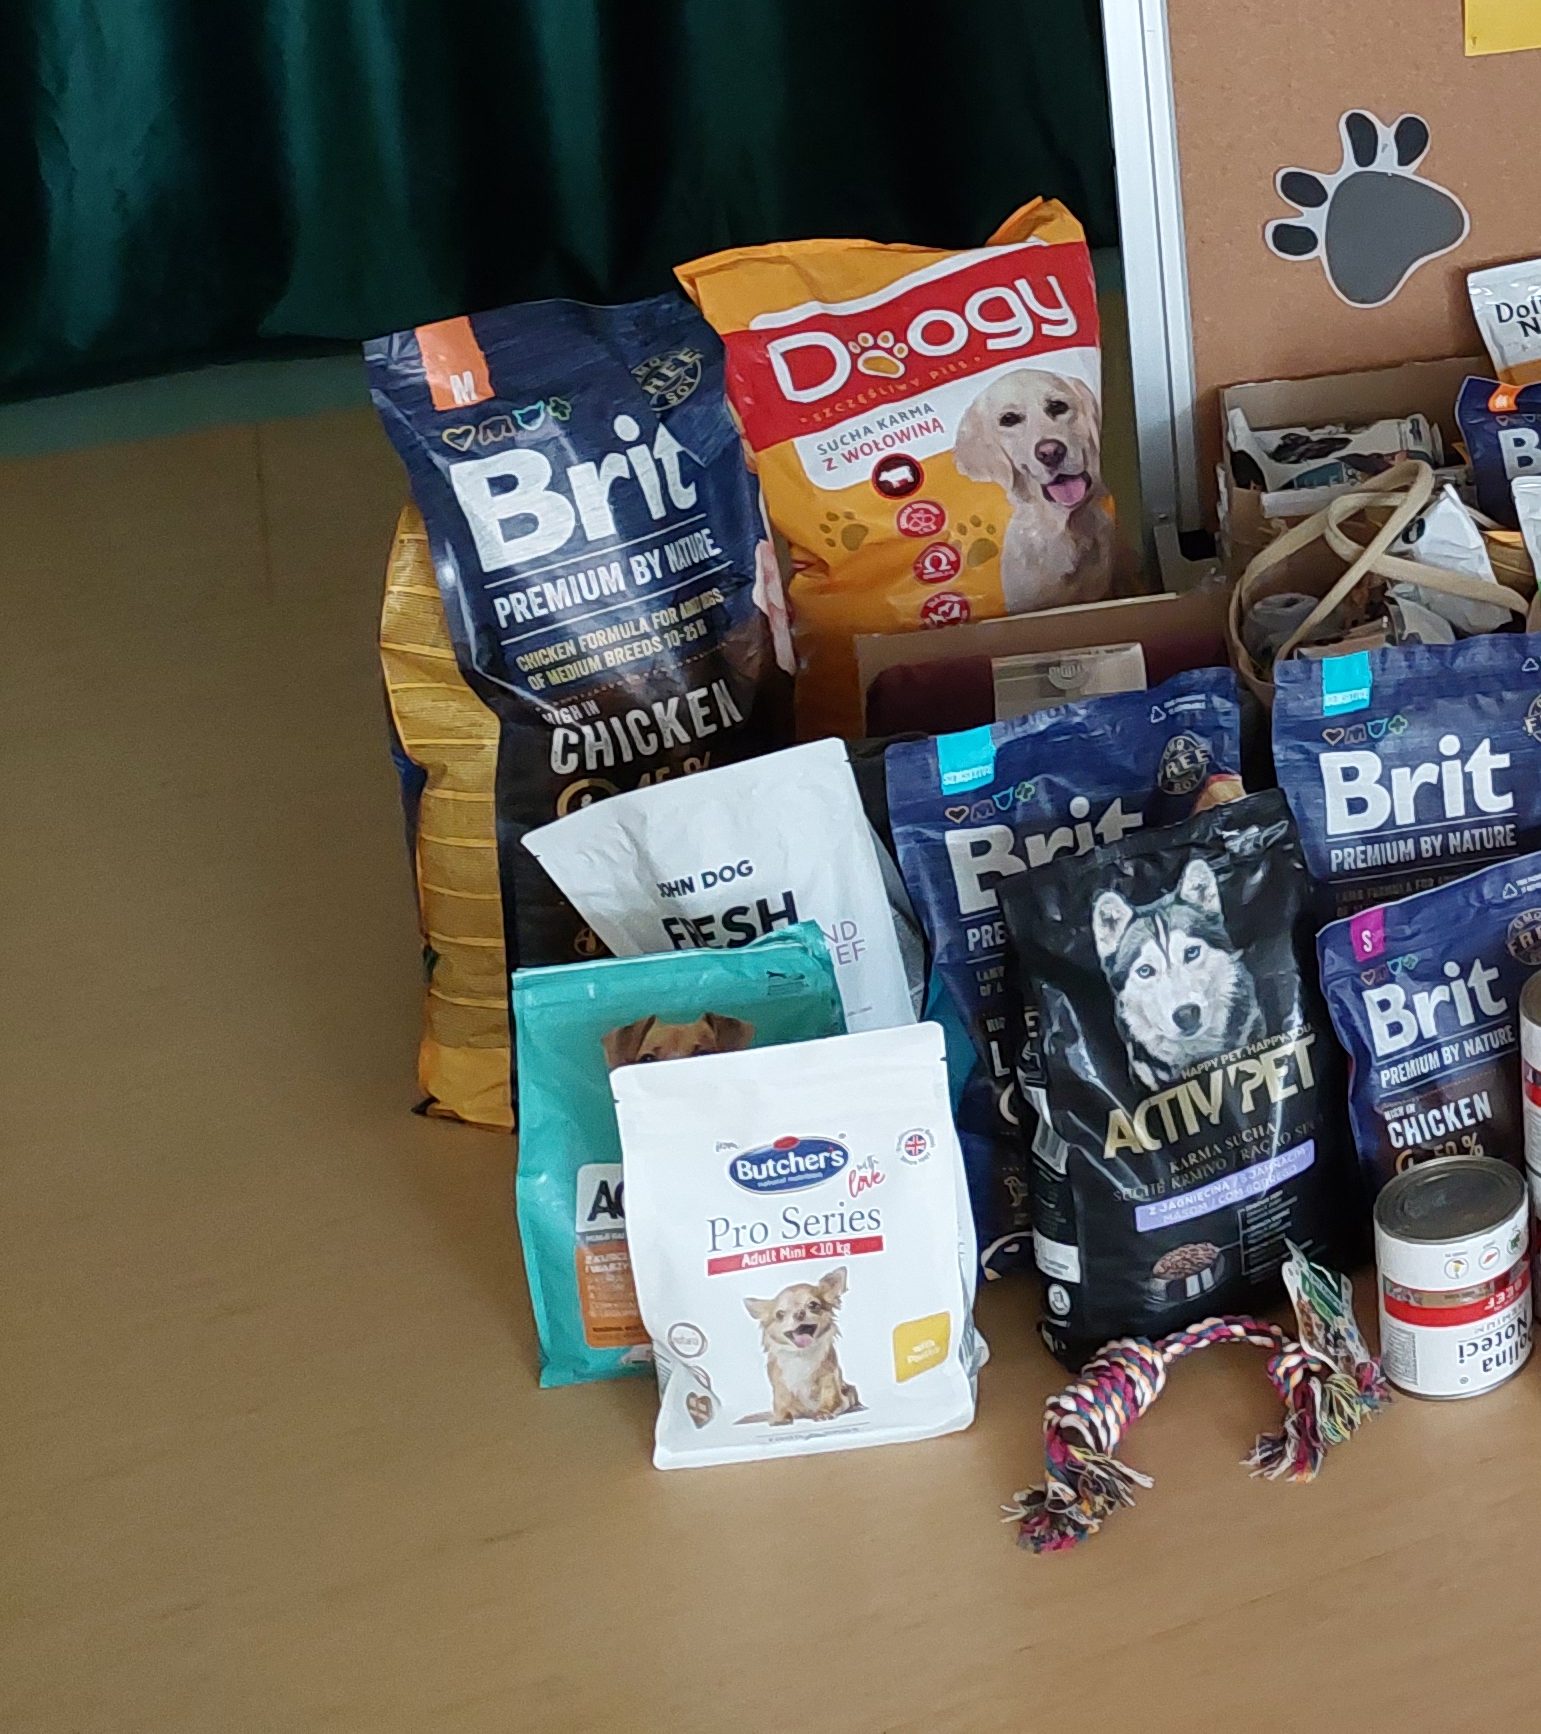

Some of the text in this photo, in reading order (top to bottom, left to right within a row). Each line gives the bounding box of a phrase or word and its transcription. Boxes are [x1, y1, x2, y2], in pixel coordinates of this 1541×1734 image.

[450, 371, 478, 405] M
[816, 402, 935, 456] SUCHA KARMA
[822, 417, 945, 472] Z WOŁOWINĄ
[448, 415, 698, 573] Brit
[493, 552, 664, 629] PREMIUM BY
[579, 606, 678, 653] FORMULA FOR
[549, 655, 602, 685] MEDIUM
[550, 679, 744, 775] CHICKEN
[1318, 735, 1514, 835] Brit
[701, 859, 754, 890] DOG
[1330, 823, 1517, 873] PREMIUM BY NATURE
[1361, 929, 1373, 952] S
[1362, 957, 1509, 1057] Brit
[1181, 1057, 1219, 1080] HAPPY
[1380, 1024, 1516, 1089] PREMIUM BY NATURE
[1387, 1091, 1493, 1149] CHICKEN
[736, 1147, 845, 1182] Butcher's
[706, 1201, 882, 1254] Pro Series
[741, 1250, 777, 1268] Adult
[780, 1245, 806, 1260] Mini
